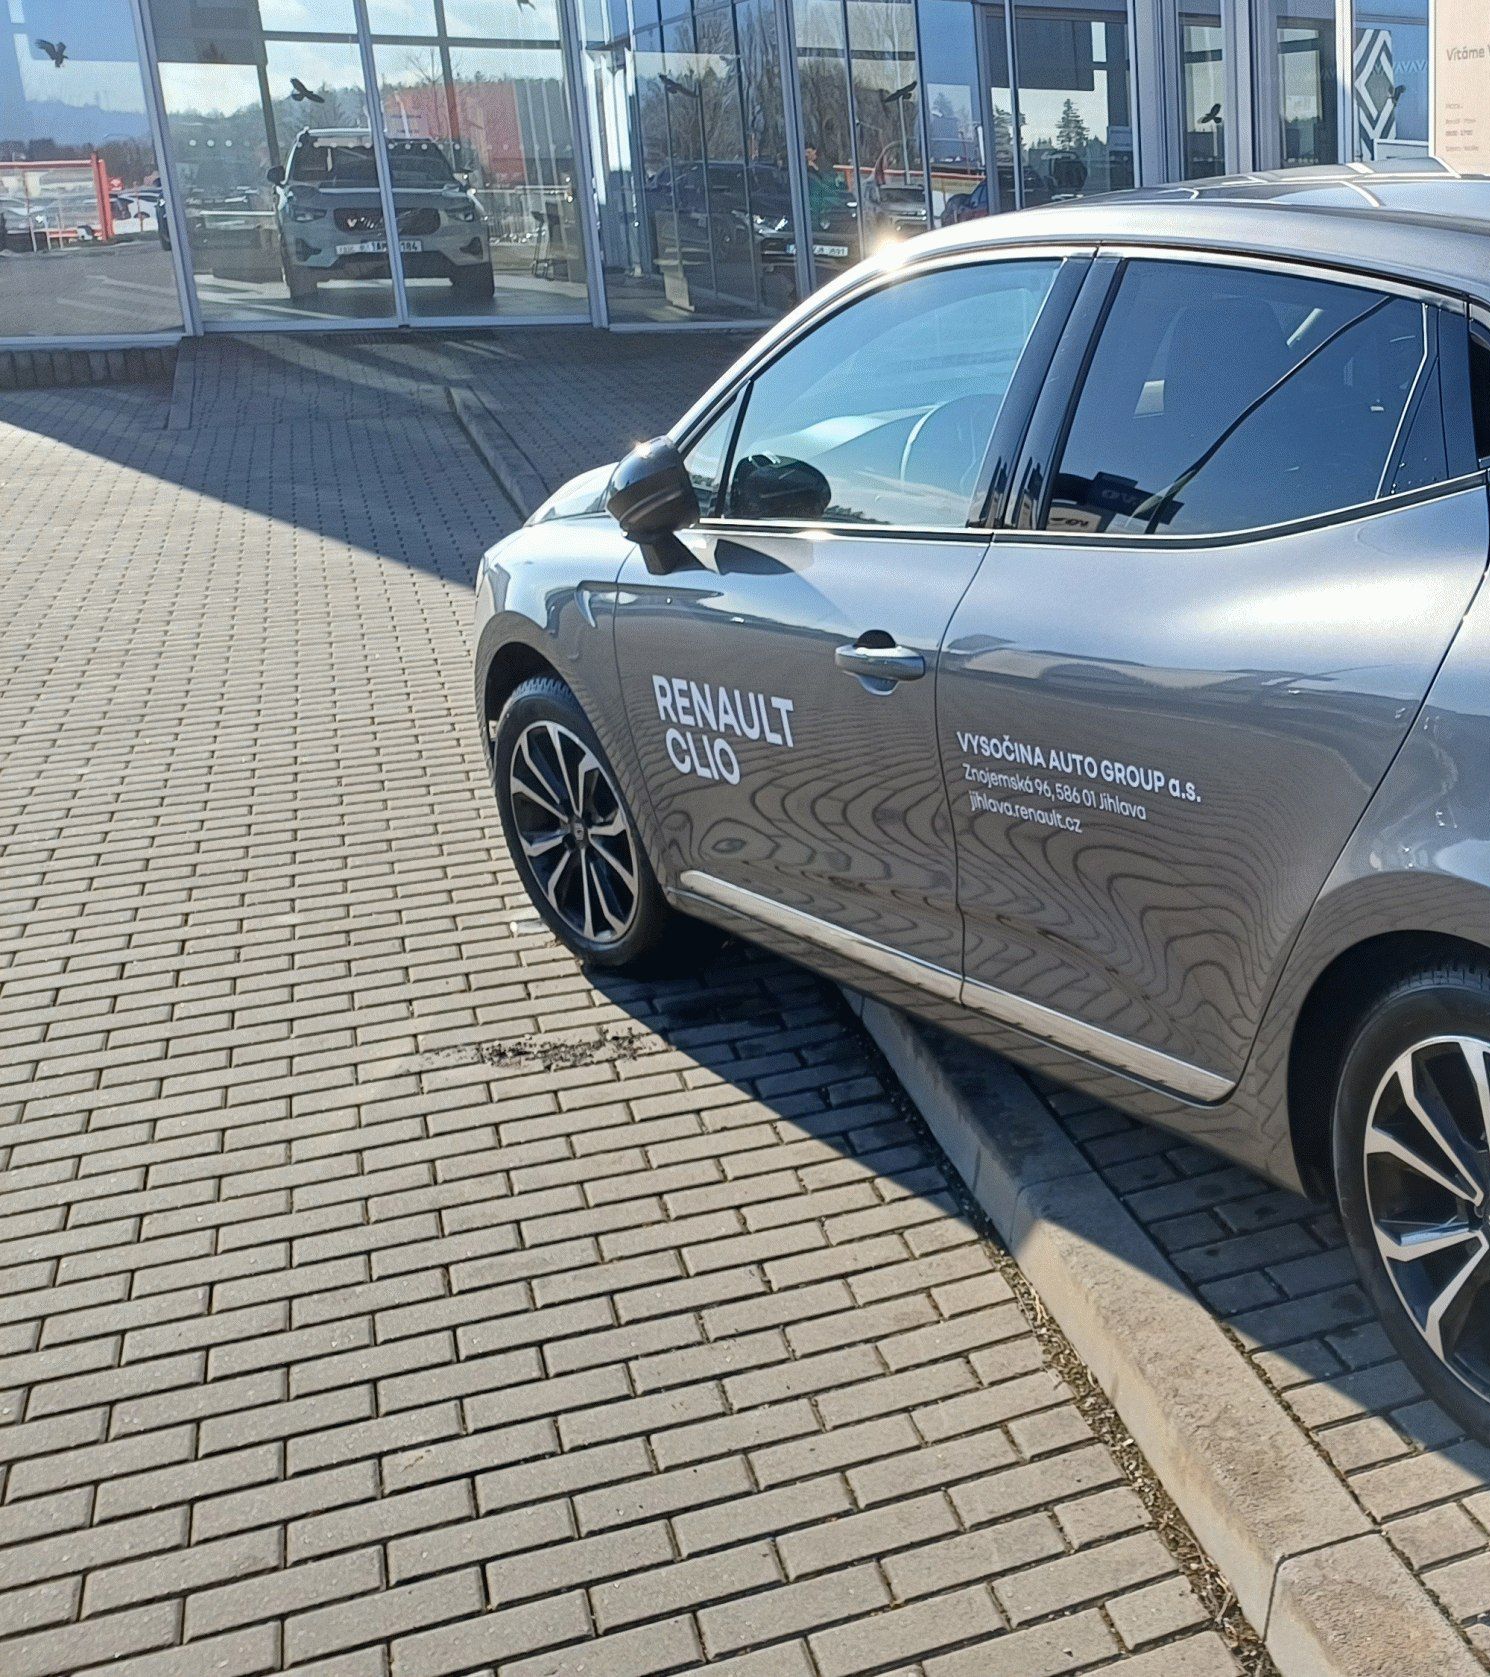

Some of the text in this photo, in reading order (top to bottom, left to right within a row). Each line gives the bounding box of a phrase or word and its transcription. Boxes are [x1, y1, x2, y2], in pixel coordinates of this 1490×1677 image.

[1446, 46, 1485, 61] Vítáme
[652, 674, 794, 748] RENAULT
[665, 727, 741, 786] CLIO
[957, 731, 1202, 803] VYSOČINA AUTO GROUP a.s.
[962, 763, 1147, 821] Znojemská 96, 586 01 Jihlava
[969, 790, 1083, 834] jihlava.renault.cz
